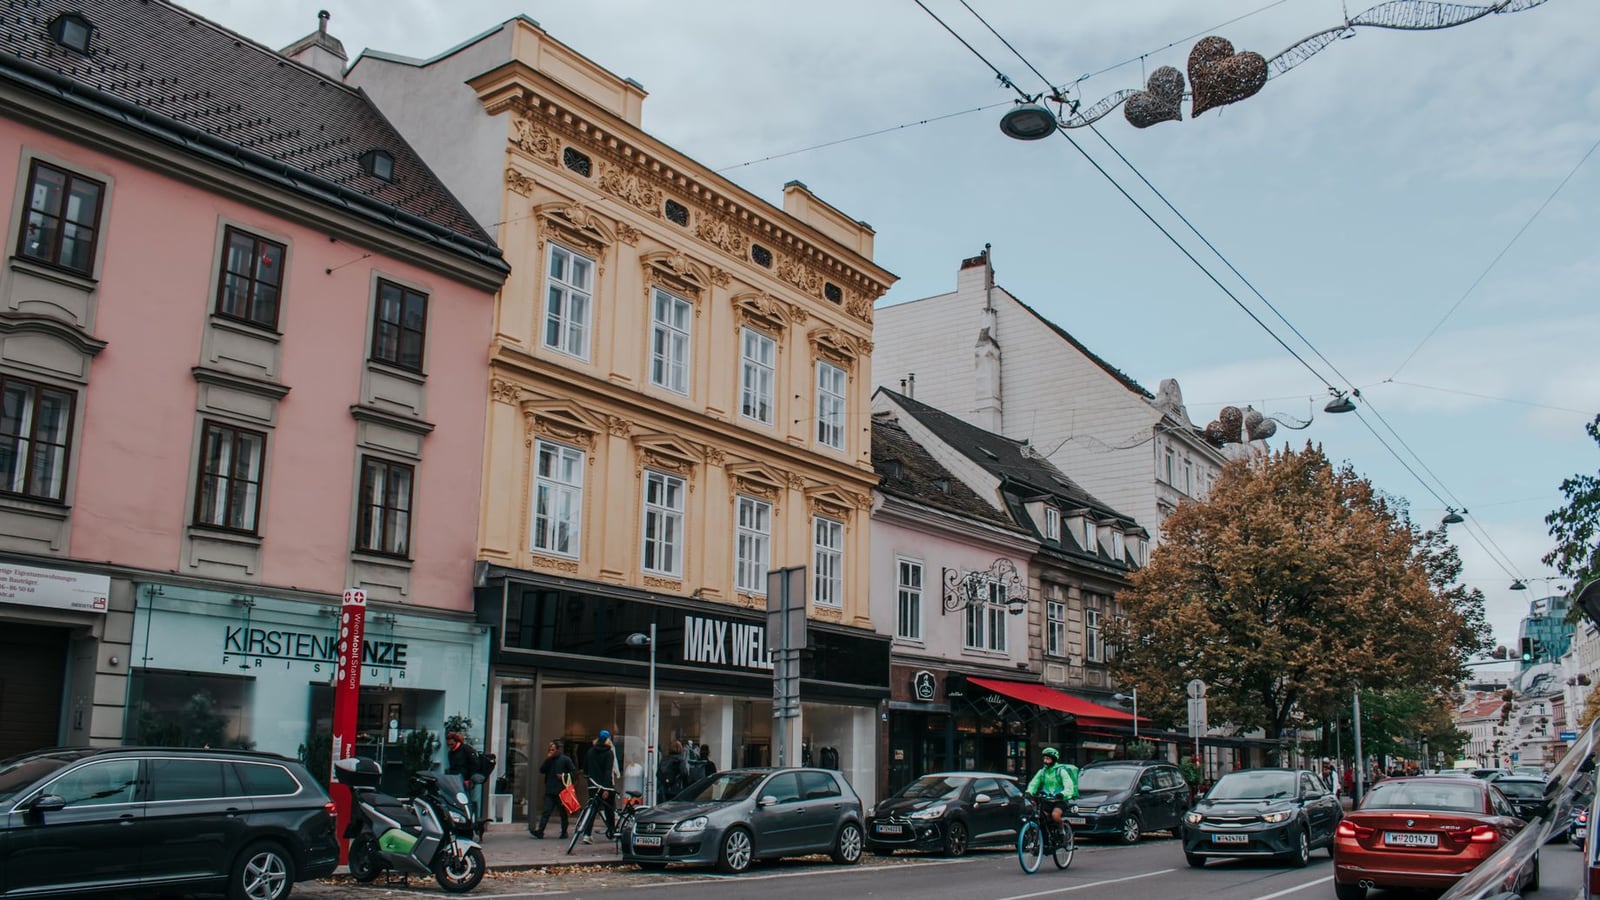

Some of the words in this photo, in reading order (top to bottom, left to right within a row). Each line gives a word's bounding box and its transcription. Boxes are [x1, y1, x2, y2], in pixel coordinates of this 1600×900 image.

[14, 569, 77, 582] Eigentumswohnungen
[225, 626, 408, 666] KIRSTENKNZE
[352, 613, 362, 658] WienMobil
[684, 616, 728, 665] MAX
[222, 656, 406, 680] FRISUR
[349, 659, 359, 690] Station
[1403, 834, 1428, 843] 20147
[1430, 836, 1436, 844] U
